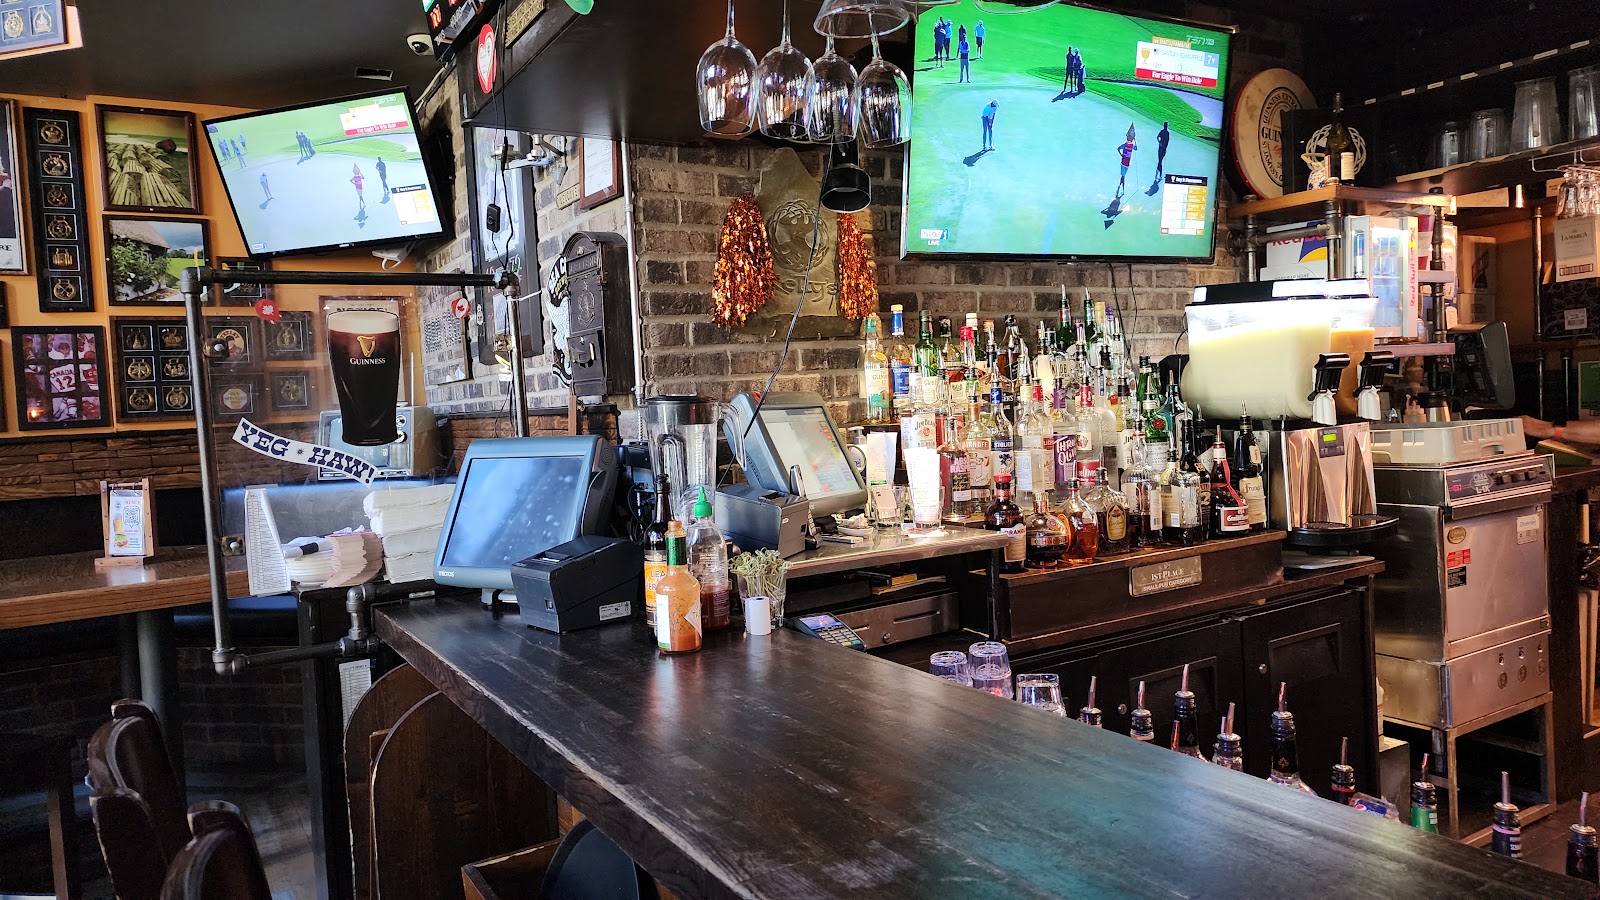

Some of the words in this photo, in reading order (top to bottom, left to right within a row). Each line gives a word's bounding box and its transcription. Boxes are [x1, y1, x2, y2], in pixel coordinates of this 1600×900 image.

[1161, 73, 1175, 81] Eagle
[1181, 75, 1192, 83] Win
[1191, 76, 1203, 84] Hole
[349, 357, 386, 366] GUINNESS
[51, 369, 74, 379] CANADA
[56, 375, 77, 390] 12
[915, 420, 923, 431] JIM
[240, 421, 291, 457] YEG
[307, 446, 375, 484] HAW!
[1473, 471, 1488, 481] CMA
[1519, 518, 1537, 528] Diversey
[438, 570, 455, 578] micros
[650, 570, 666, 578] LEA
[1151, 572, 1163, 581] 1ST
[1162, 568, 1185, 579] PLACE
[1168, 576, 1192, 587] CATEGORY
